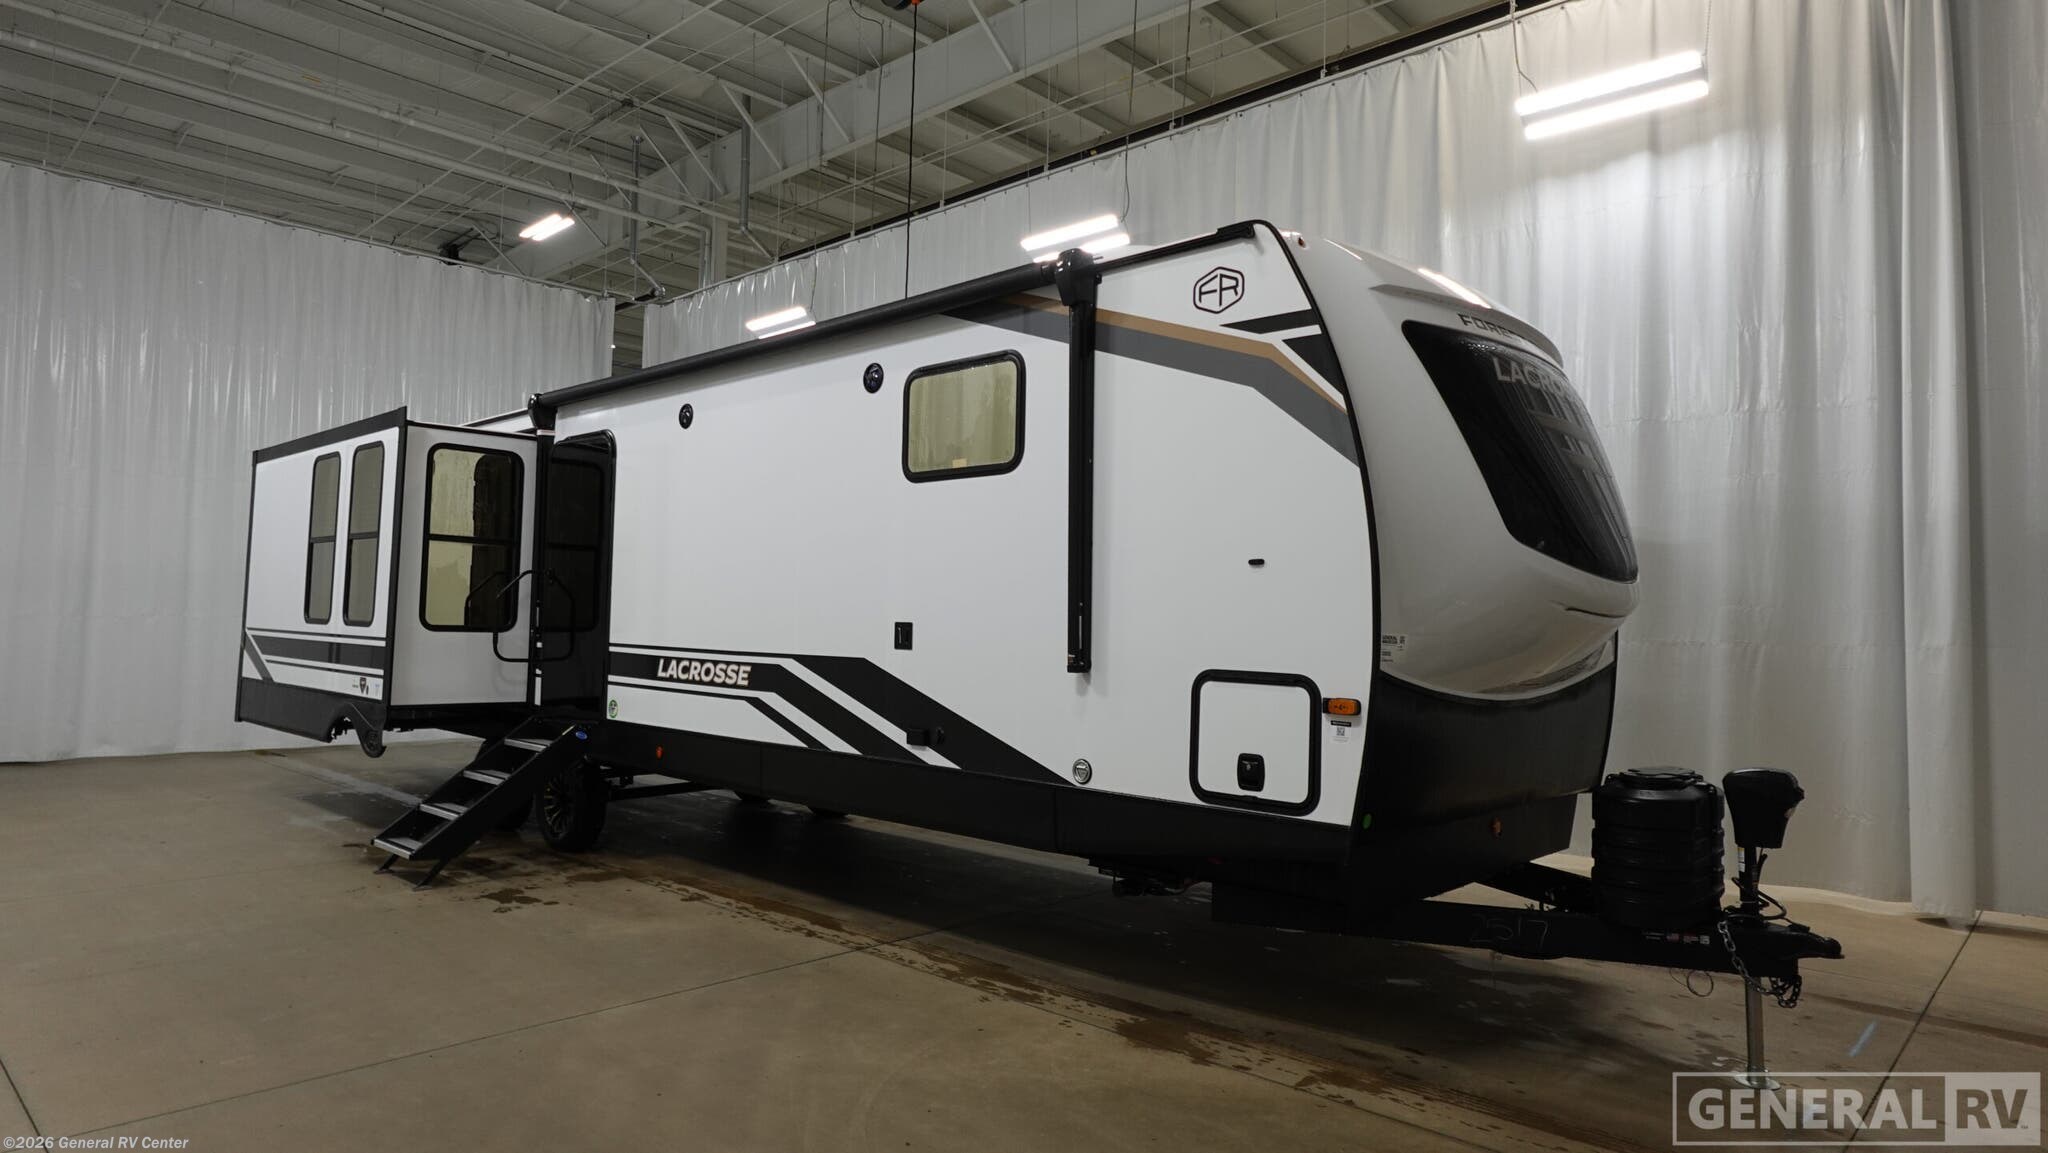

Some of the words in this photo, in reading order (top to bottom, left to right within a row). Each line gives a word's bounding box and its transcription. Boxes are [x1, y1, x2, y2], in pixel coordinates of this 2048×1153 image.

[1198, 273, 1239, 307] FR
[1457, 313, 1514, 339] FORE
[657, 658, 752, 687] LACROSSE
